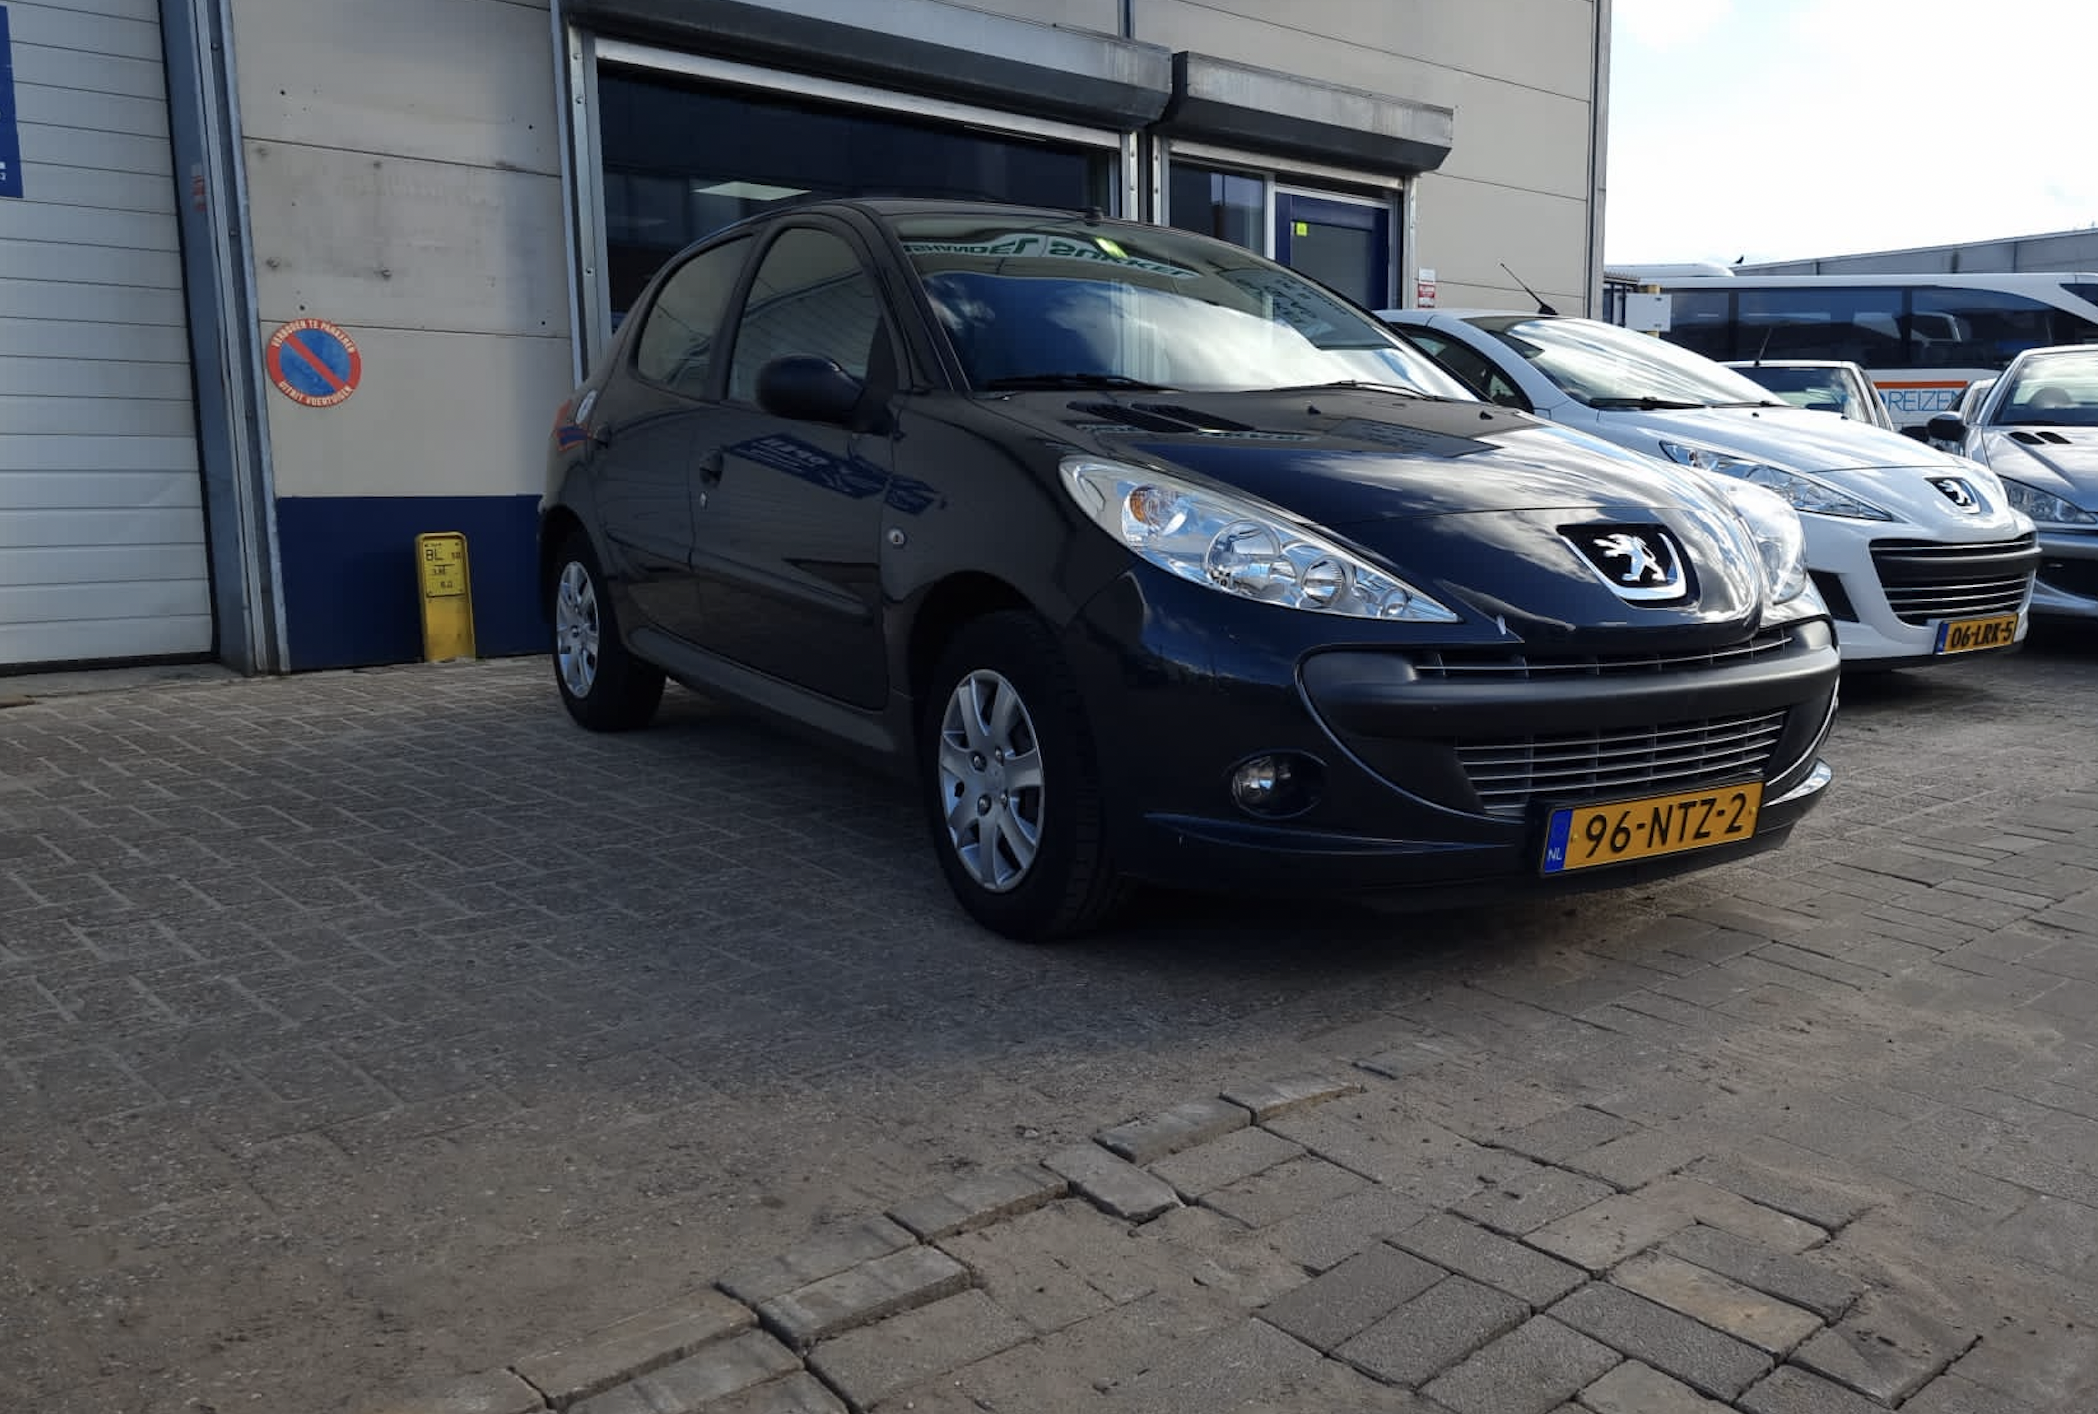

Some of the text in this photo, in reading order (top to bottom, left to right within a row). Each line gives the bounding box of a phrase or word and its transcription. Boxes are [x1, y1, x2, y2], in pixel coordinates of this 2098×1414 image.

[271, 320, 355, 353] VERBODEN TE PARKEREN
[1951, 621, 2014, 648] 06-LRK-5
[1585, 792, 1747, 858] 96-NTZ-2
[1547, 849, 1563, 862] NL
